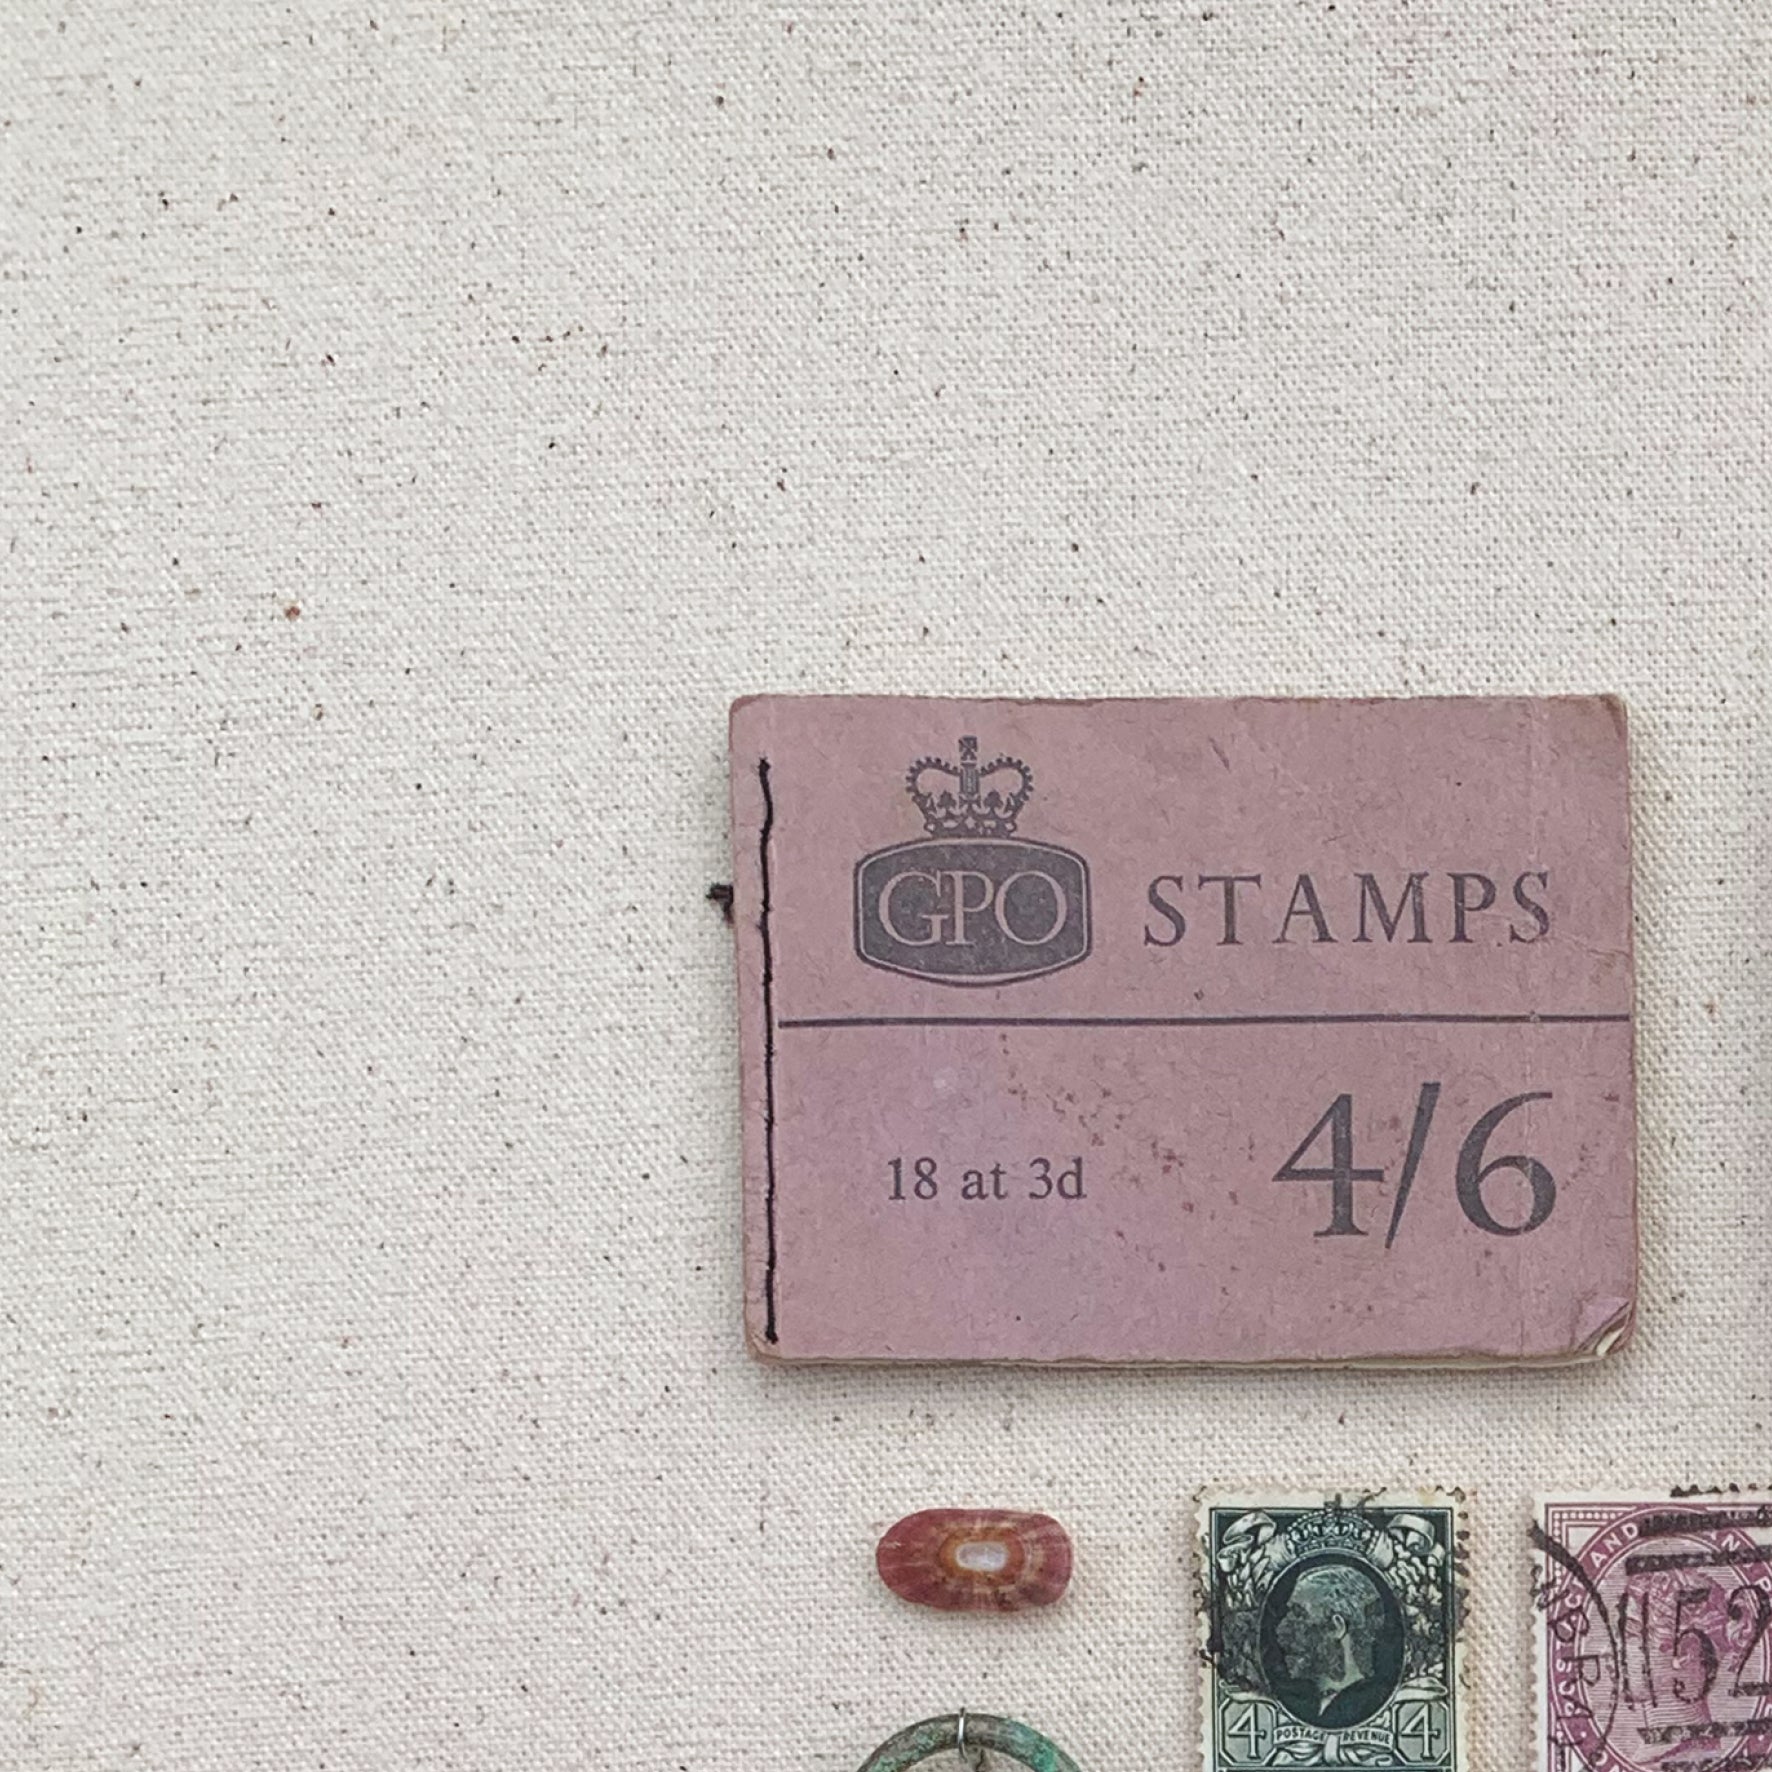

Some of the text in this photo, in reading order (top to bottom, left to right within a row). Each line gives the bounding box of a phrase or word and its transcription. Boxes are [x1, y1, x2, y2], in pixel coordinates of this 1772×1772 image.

[878, 869, 1068, 948] GPO
[1143, 871, 1552, 949] STAMPS
[885, 1156, 1088, 1203] 18 at 3d
[1272, 1081, 1557, 1249] 4/6
[1590, 1522, 1638, 1568] AND
[1228, 1703, 1266, 1758] 4
[1276, 1728, 1391, 1743] POSTAGE REVENUE
[1401, 1703, 1441, 1758] 4
